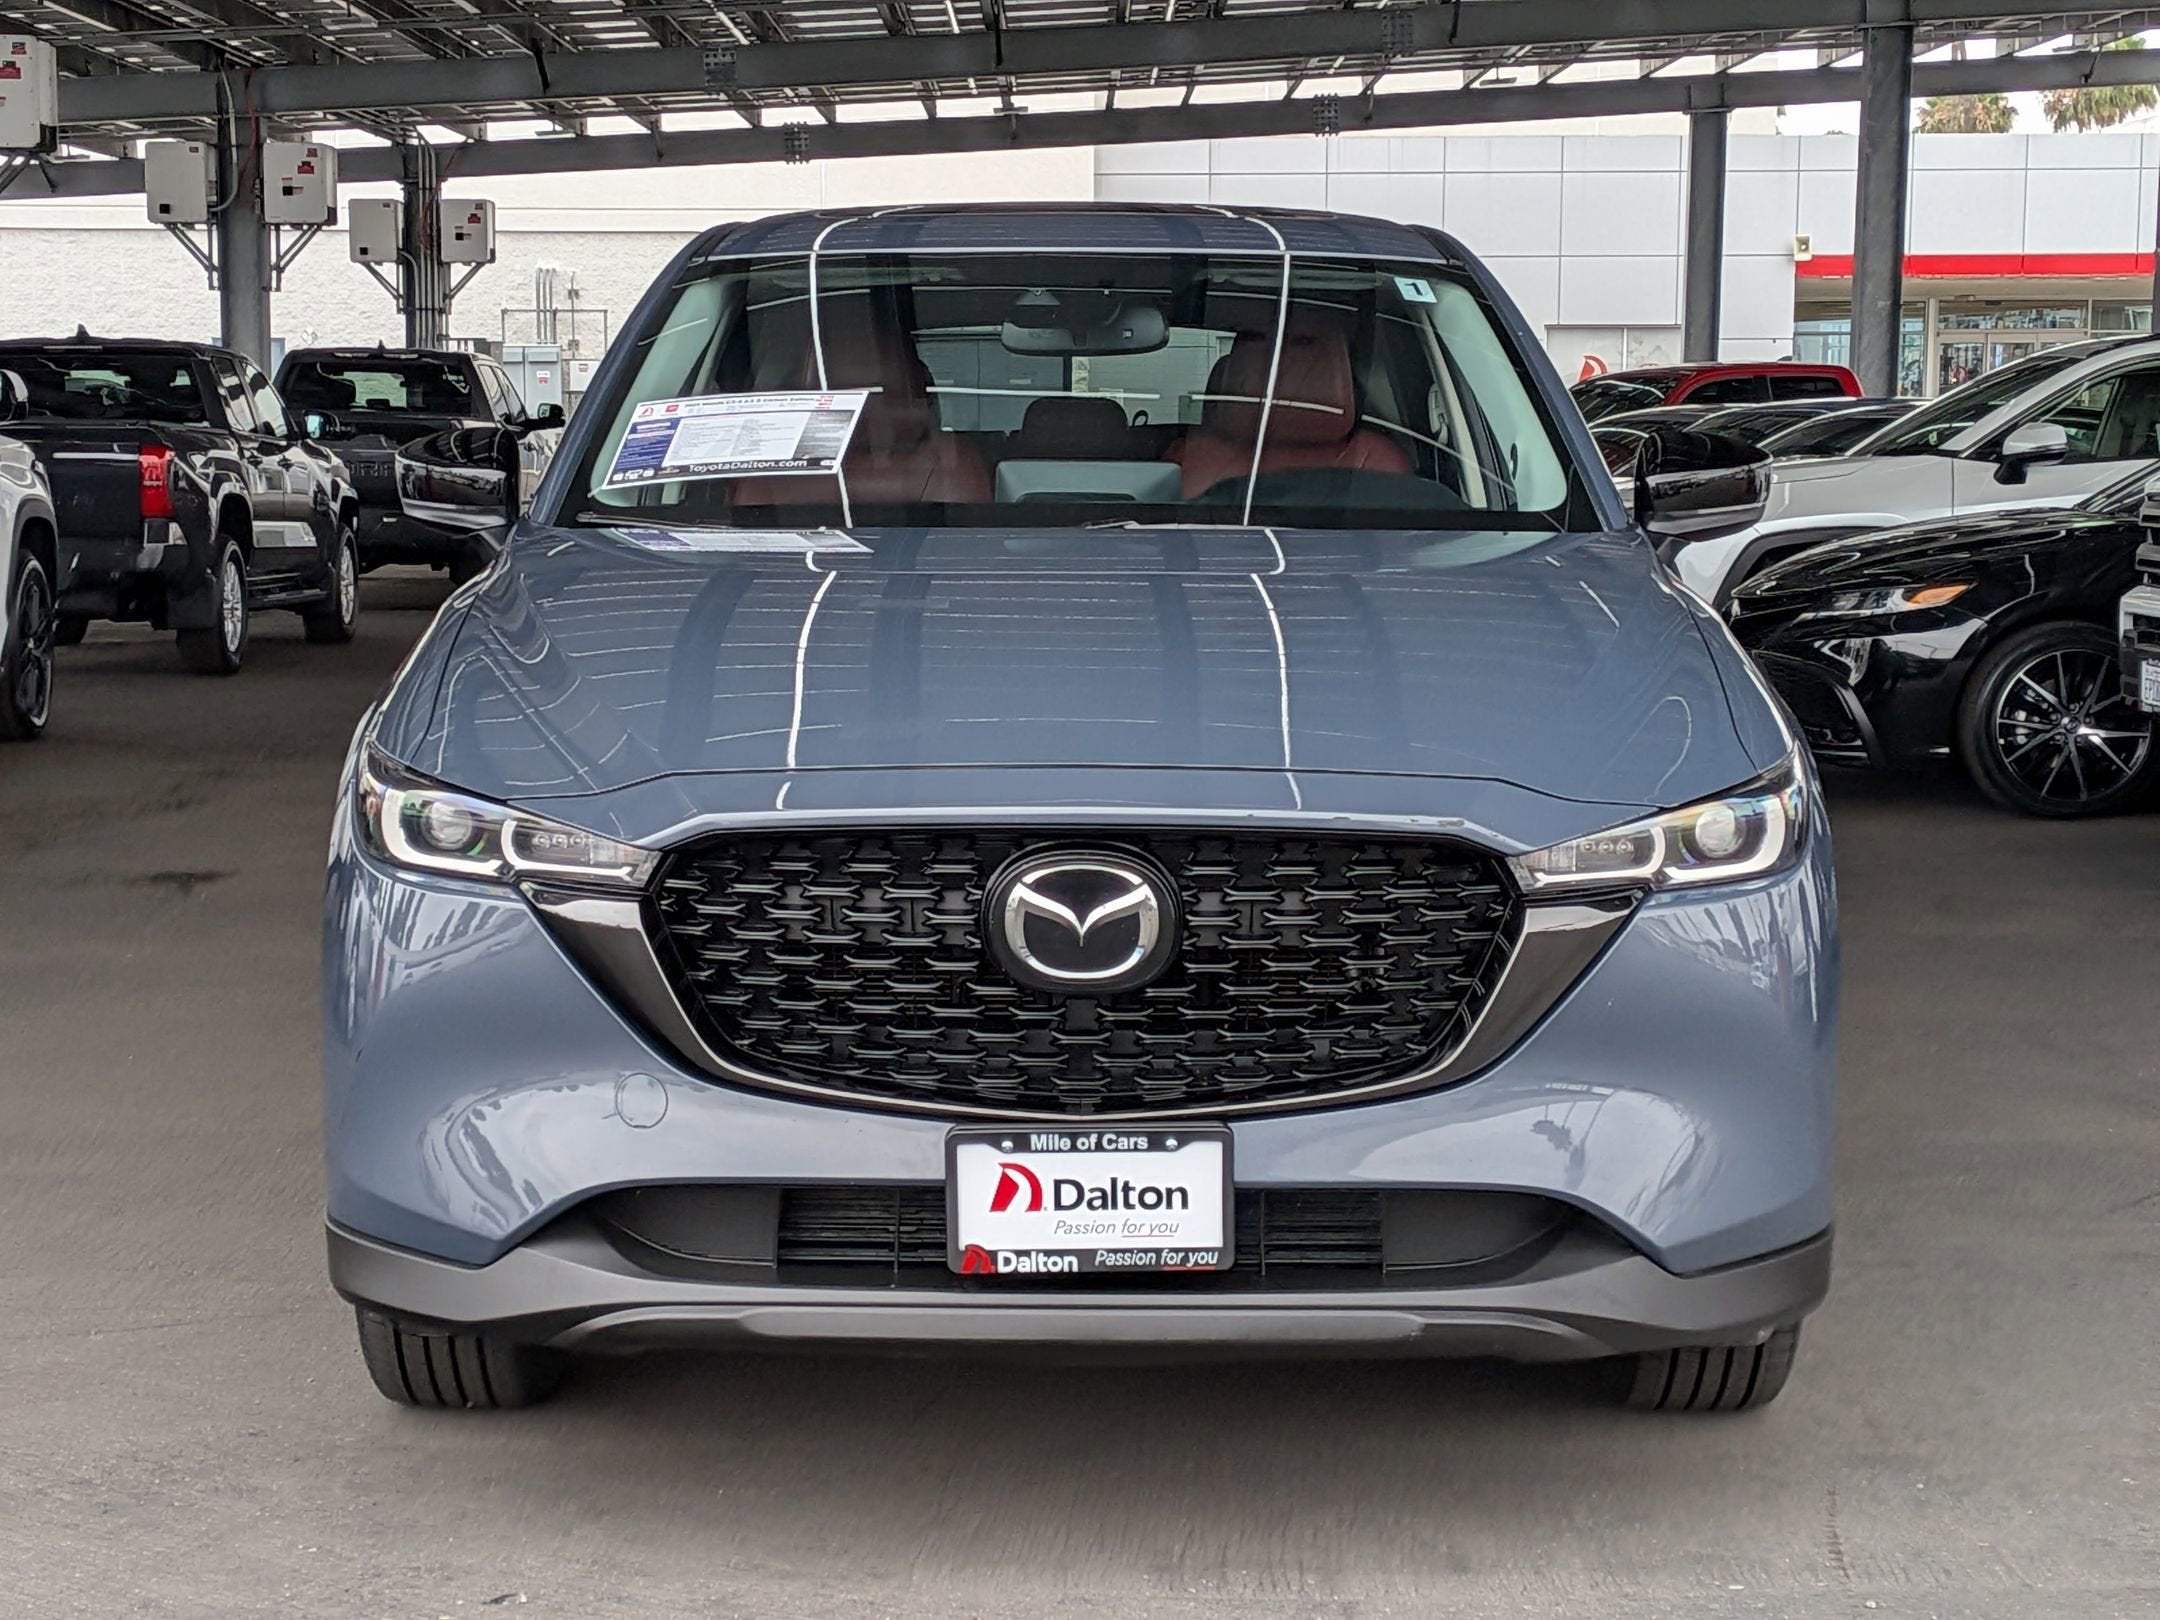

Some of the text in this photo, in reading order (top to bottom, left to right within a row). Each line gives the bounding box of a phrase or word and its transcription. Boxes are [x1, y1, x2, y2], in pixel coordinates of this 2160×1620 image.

[688, 459, 808, 474] ToyotaDalton.com
[1030, 1133, 1149, 1151] Mile of Cars
[1053, 1177, 1189, 1212] Dalton
[1054, 1218, 1180, 1236] Passion for you
[997, 1251, 1079, 1274] Dalton
[1094, 1249, 1219, 1268] Passion for you
